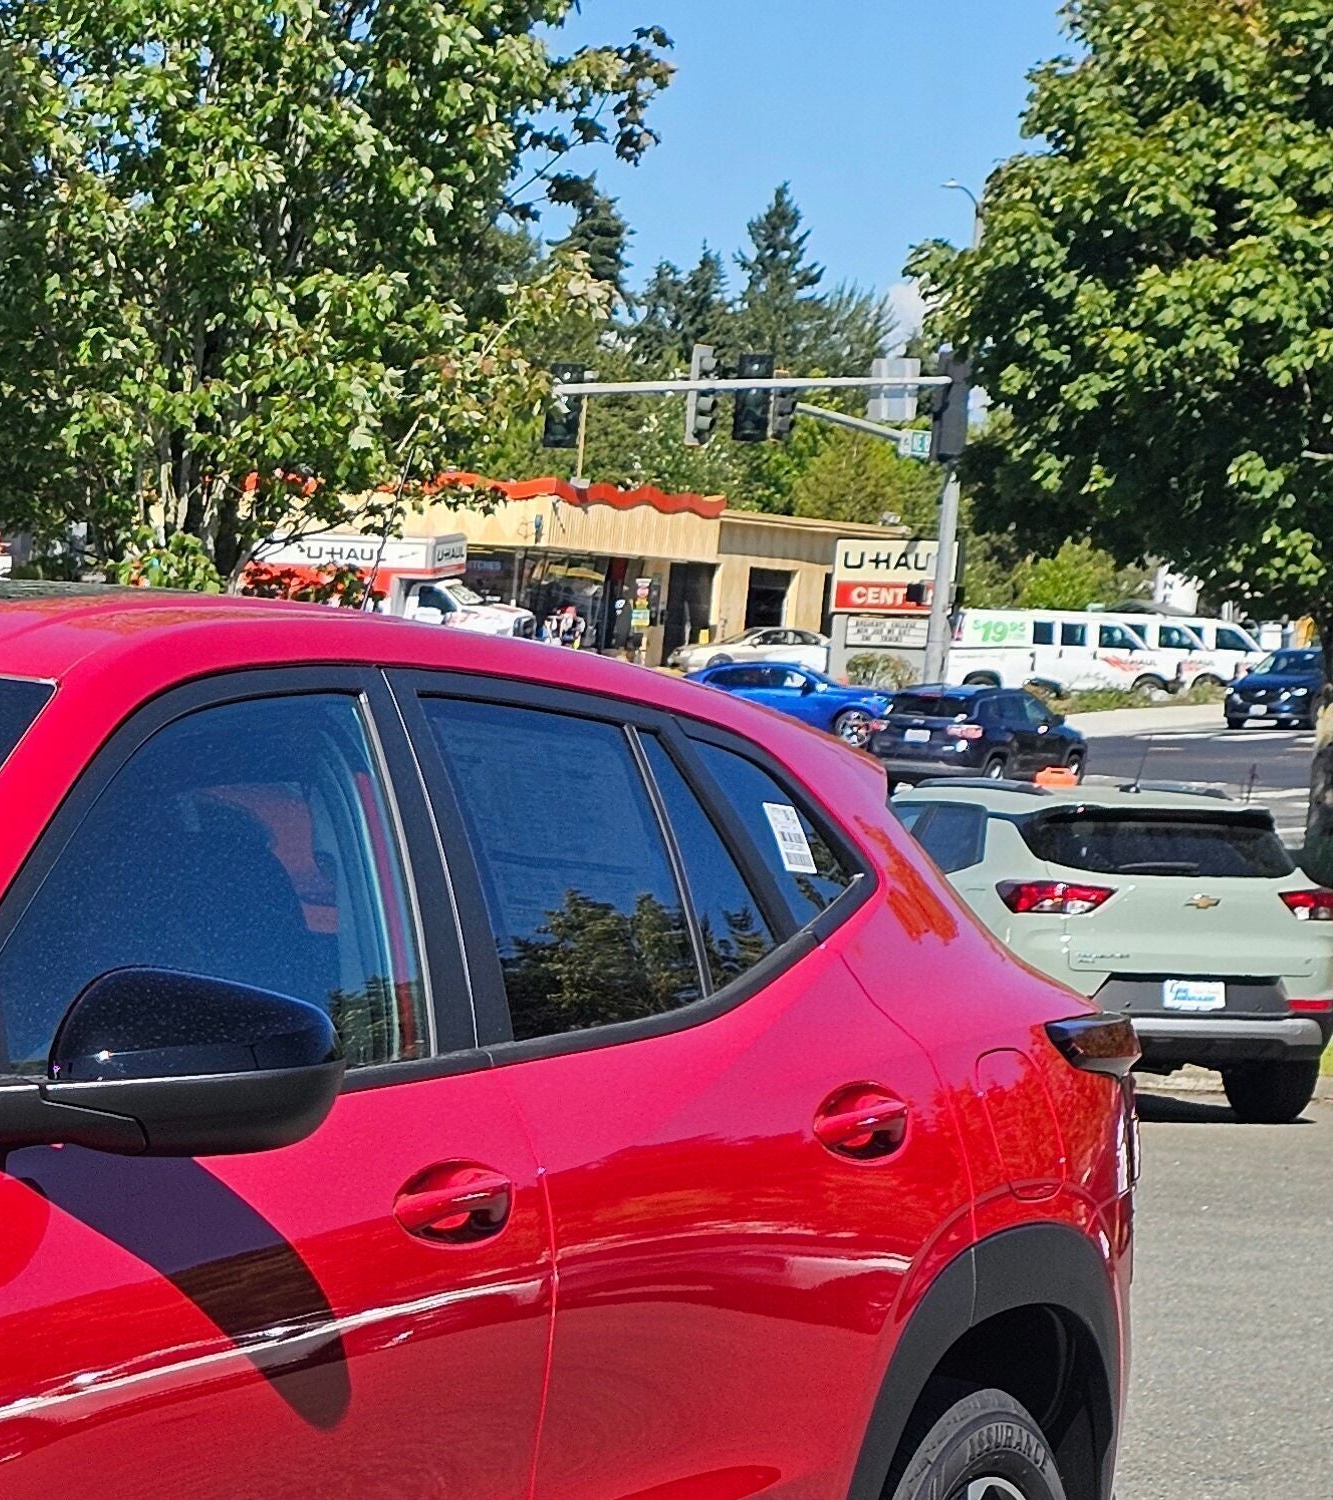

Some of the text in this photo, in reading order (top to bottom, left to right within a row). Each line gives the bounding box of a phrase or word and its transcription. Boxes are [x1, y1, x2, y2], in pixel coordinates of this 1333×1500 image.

[844, 551, 932, 571] U-HAU
[851, 586, 933, 606] CENT
[968, 1423, 1049, 1474] ASSURANCE
